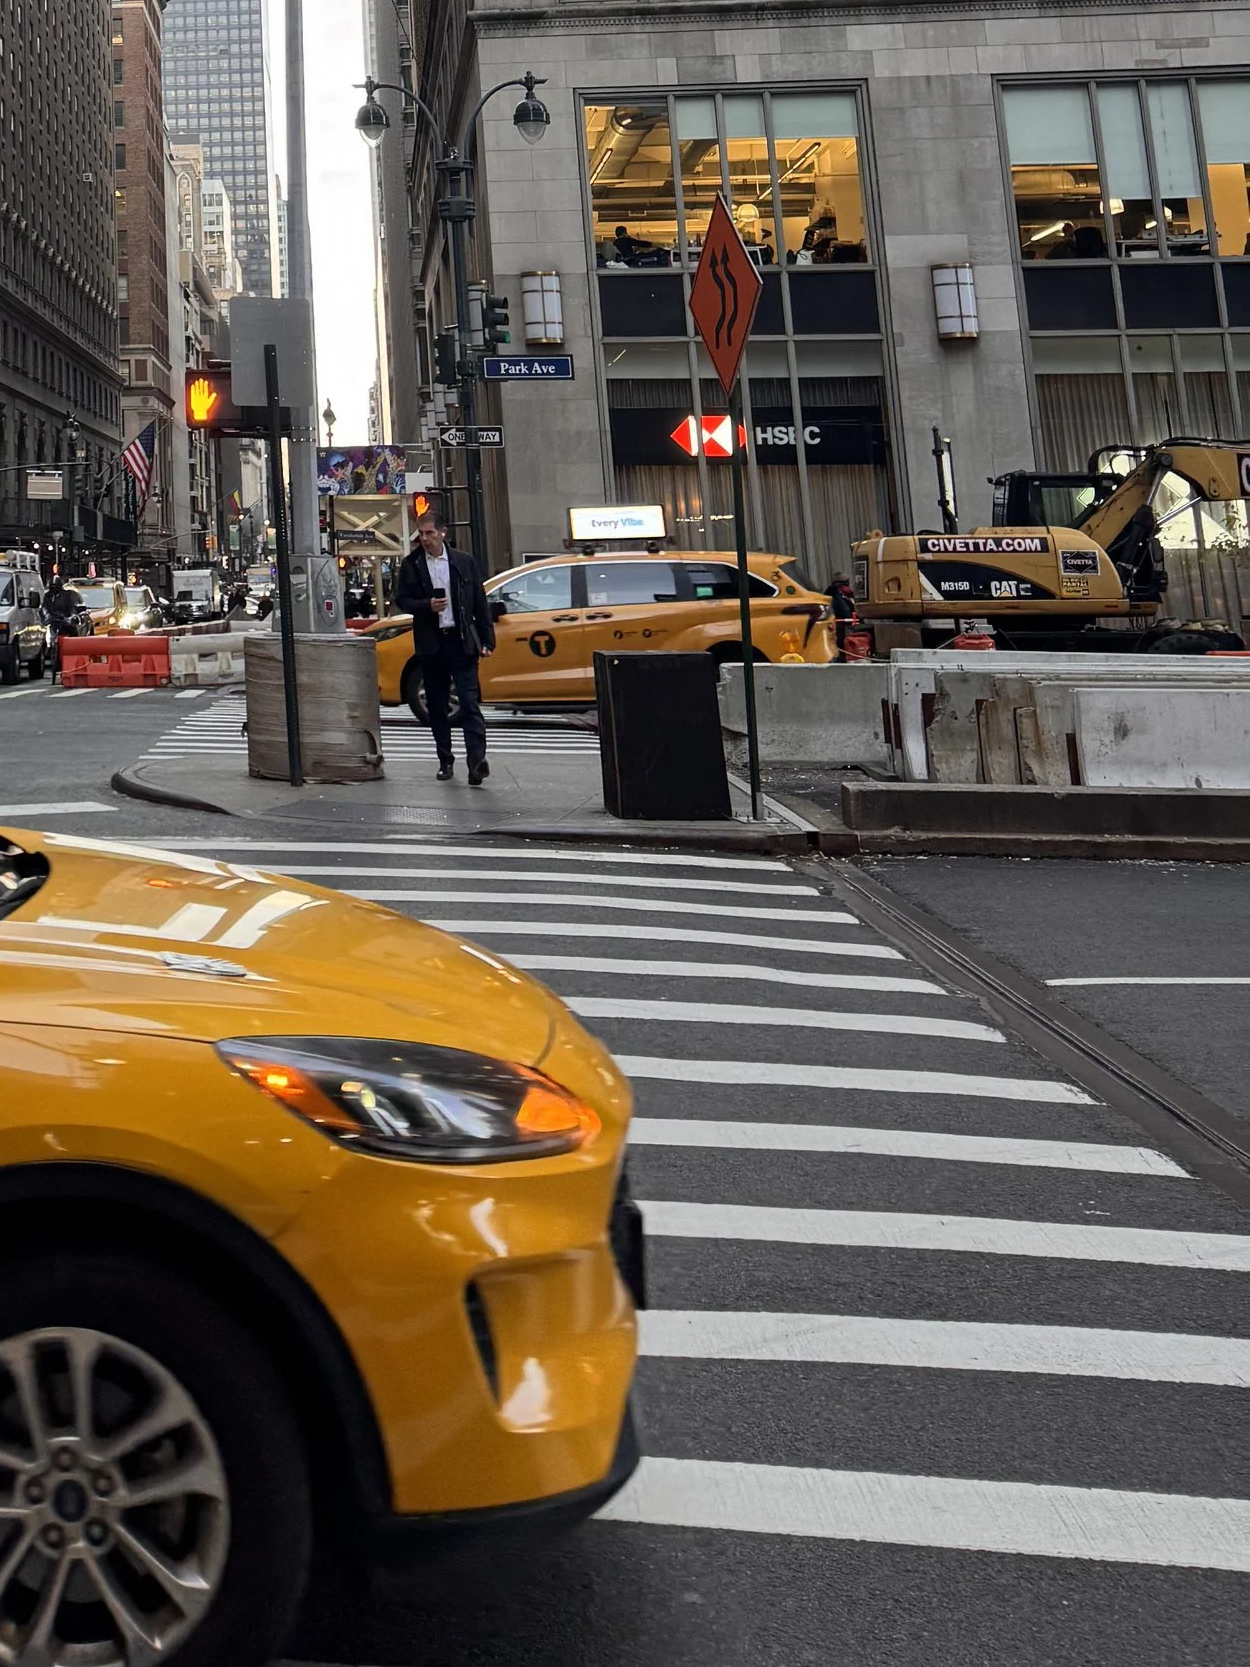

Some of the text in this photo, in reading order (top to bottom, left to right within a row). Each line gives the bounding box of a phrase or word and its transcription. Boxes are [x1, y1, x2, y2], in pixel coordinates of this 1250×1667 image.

[500, 362, 556, 374] Park Ave
[447, 431, 466, 442] ONE
[591, 517, 644, 529] Every Vibe
[926, 537, 1042, 552] CIVETTA.COM
[940, 580, 1018, 598] M315D CAT
[533, 634, 549, 655] T
